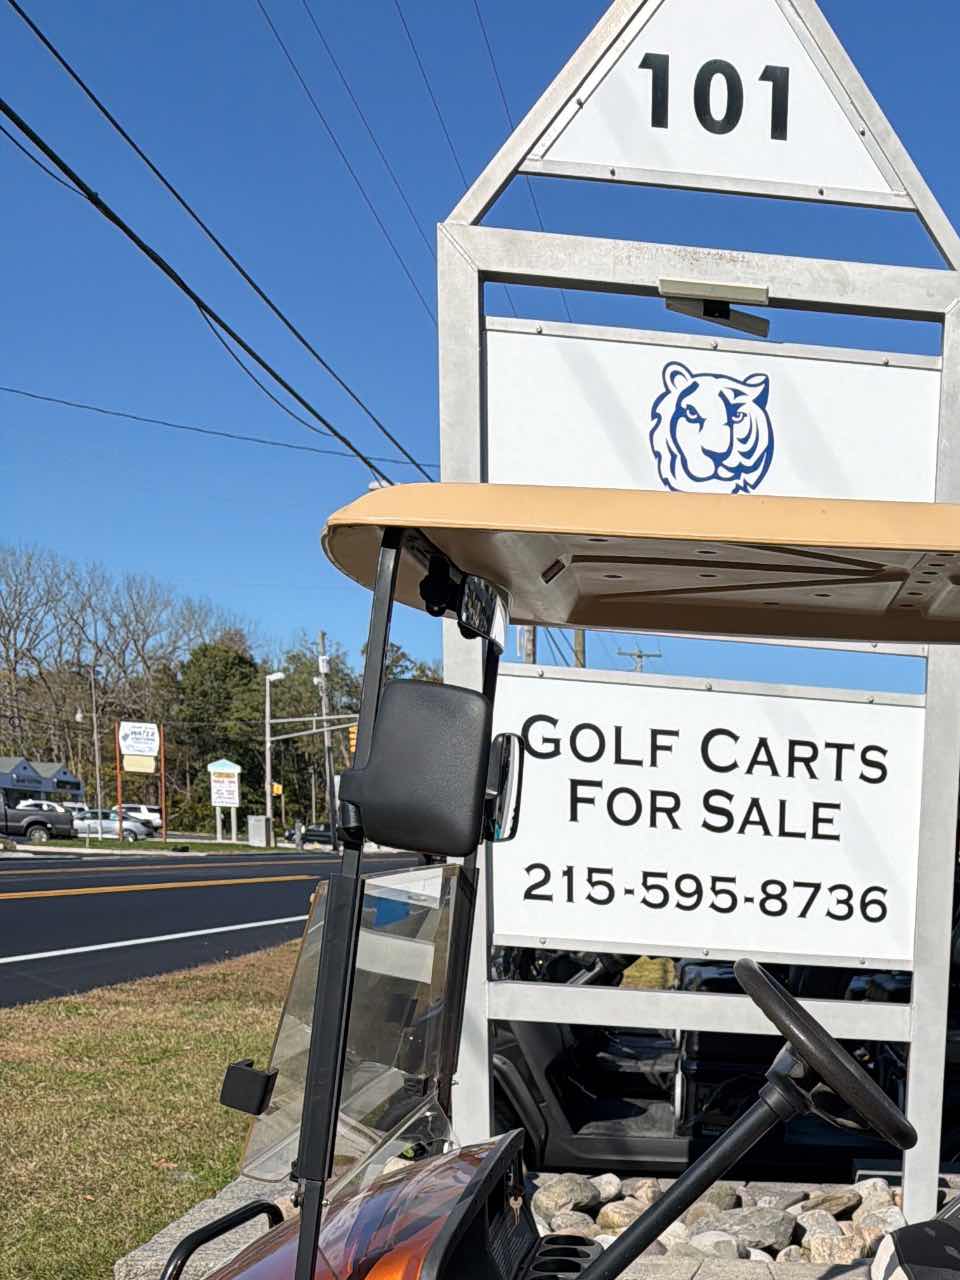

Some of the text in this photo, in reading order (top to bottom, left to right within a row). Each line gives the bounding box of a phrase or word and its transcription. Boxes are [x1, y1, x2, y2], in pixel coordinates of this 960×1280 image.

[638, 52, 789, 141] 101
[521, 713, 888, 784] GOLF CARTS
[569, 778, 841, 841] FOR SALE
[523, 863, 888, 923] 215-595-8736
